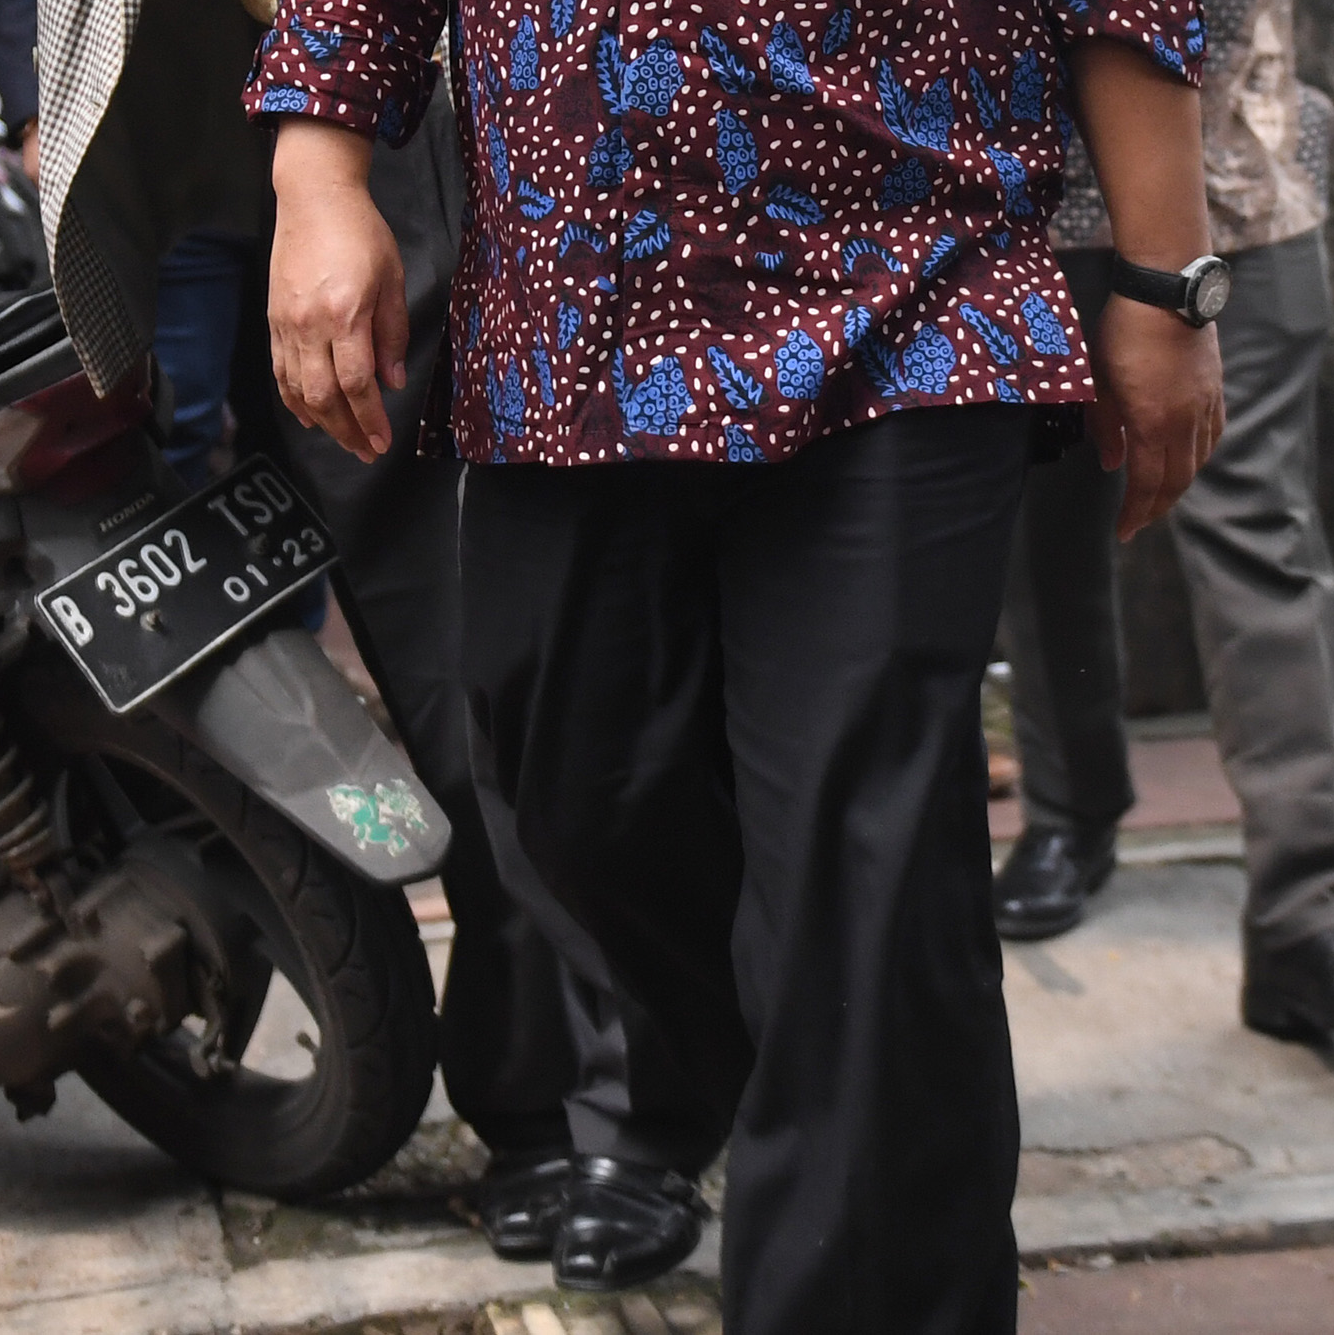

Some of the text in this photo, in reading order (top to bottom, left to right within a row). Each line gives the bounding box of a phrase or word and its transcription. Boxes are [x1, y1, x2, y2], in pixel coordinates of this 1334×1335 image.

[99, 493, 155, 533] HONDA
[50, 595, 94, 647] B
[95, 529, 207, 617] 3602
